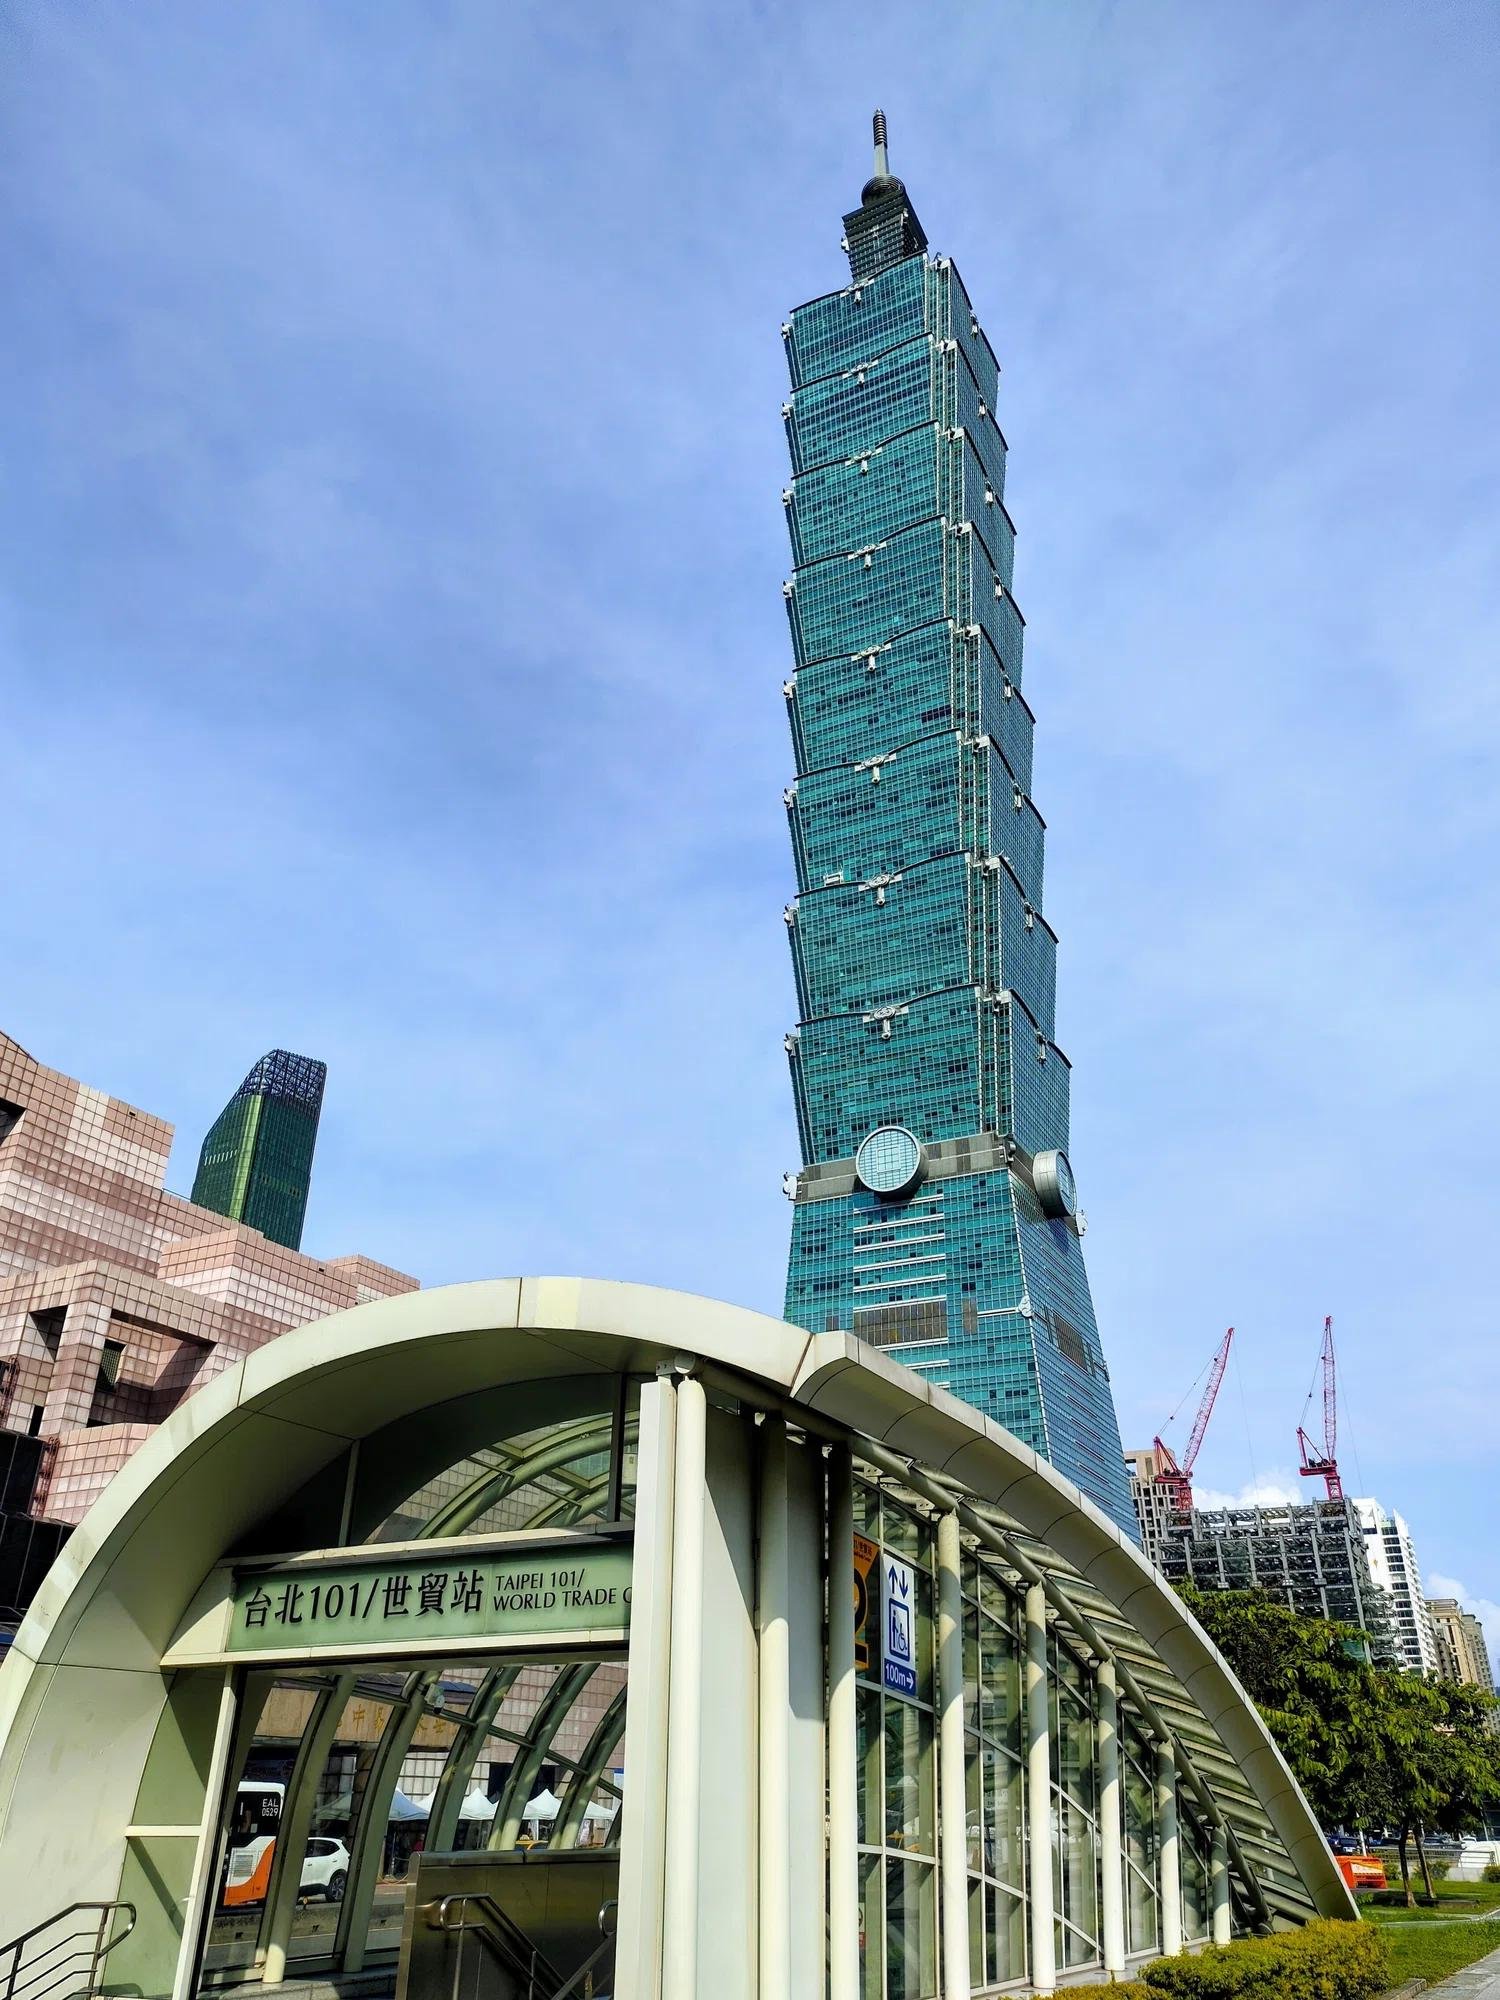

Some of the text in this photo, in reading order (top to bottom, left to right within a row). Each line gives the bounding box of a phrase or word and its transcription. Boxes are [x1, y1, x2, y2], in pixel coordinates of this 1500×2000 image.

[496, 1568, 585, 1590] TAIPEI 101/
[245, 1569, 484, 1627] 台北101/世貿站
[493, 1593, 555, 1611] WORLD
[563, 1589, 617, 1607] TRADE
[885, 1663, 906, 1687] 100m
[261, 1807, 279, 1817] 0529
[262, 1798, 279, 1807] EAL
